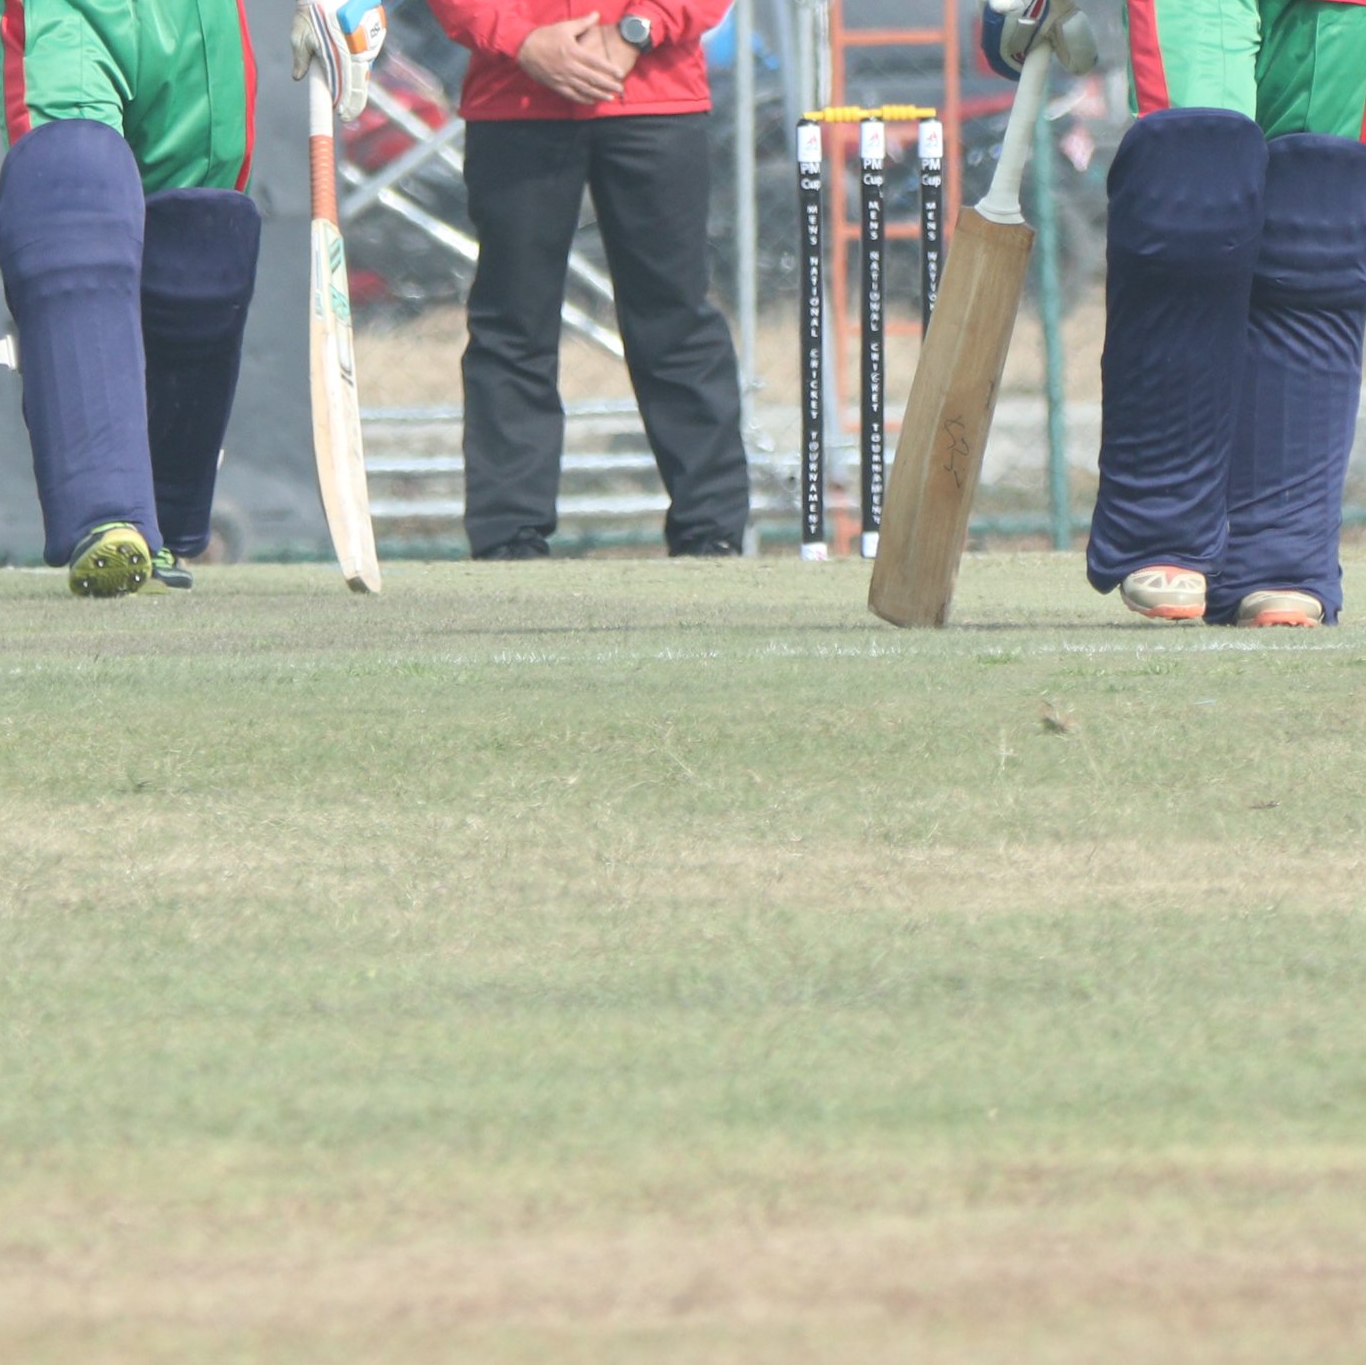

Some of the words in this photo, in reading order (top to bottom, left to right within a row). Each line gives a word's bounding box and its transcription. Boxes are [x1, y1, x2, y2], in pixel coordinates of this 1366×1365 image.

[800, 162, 821, 175] PM
[863, 158, 883, 171] PM
[863, 173, 884, 188] Cup
[921, 158, 941, 171] PM
[921, 174, 942, 188] Cup
[800, 178, 822, 192] Cup
[806, 204, 819, 246] MENS
[868, 201, 880, 240] MENS
[925, 202, 937, 242] MENS
[809, 256, 820, 338] NATIONAL
[869, 250, 881, 332] NATIONAL
[809, 348, 819, 420] CRICKET
[870, 342, 880, 413] CRICKET
[808, 430, 819, 535] TOURNAMENT
[870, 422, 883, 525] TOURNAMENT
